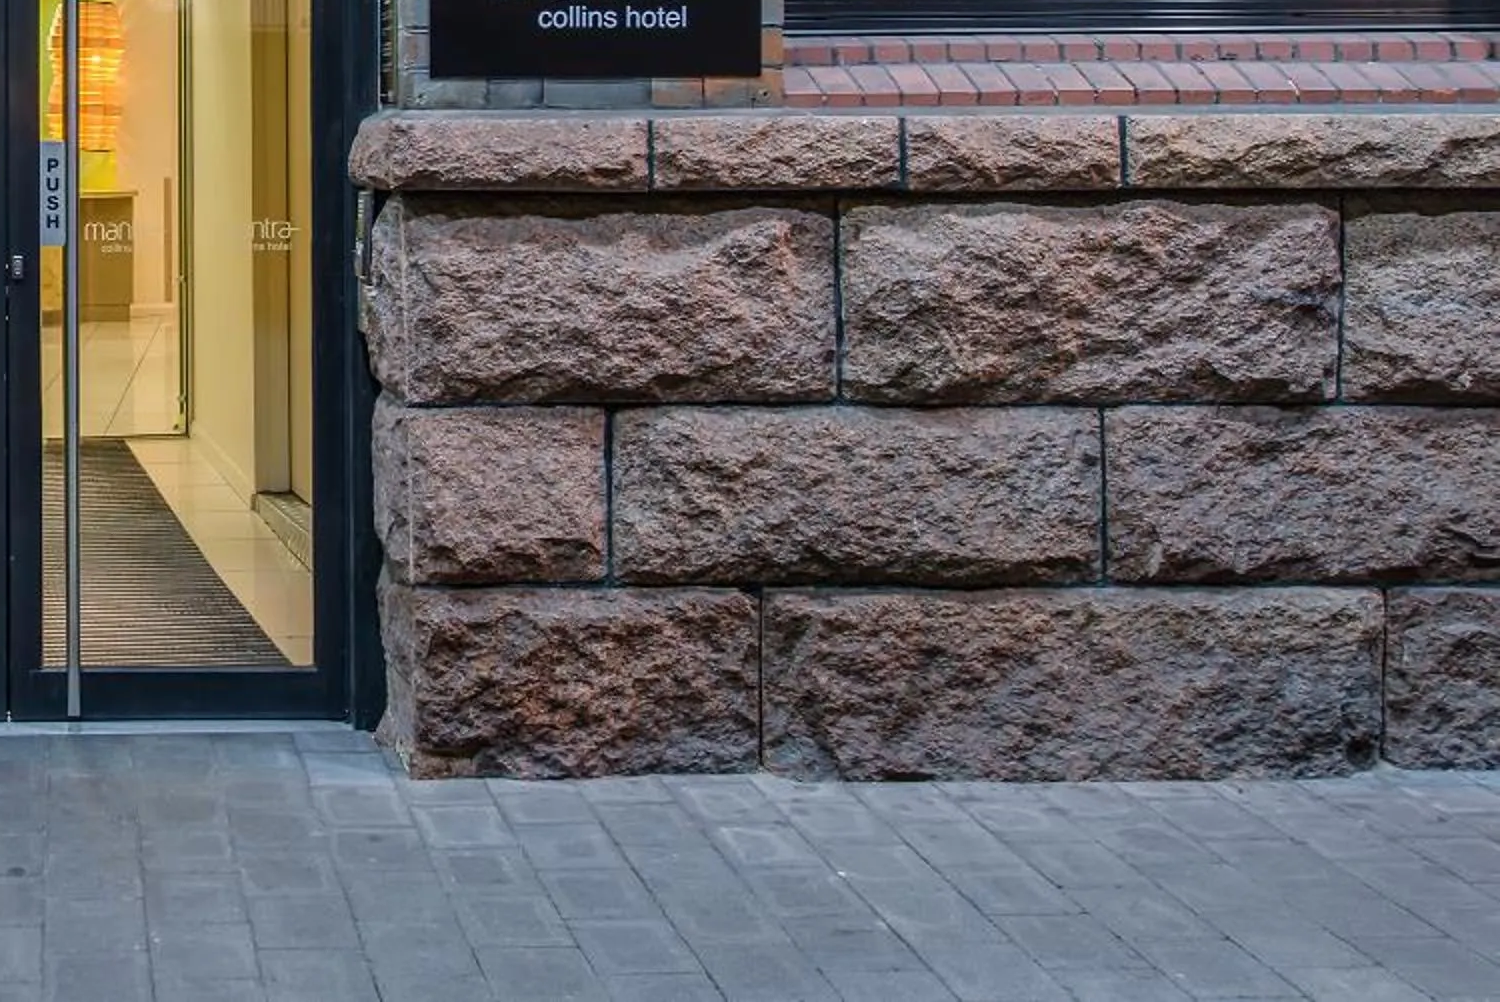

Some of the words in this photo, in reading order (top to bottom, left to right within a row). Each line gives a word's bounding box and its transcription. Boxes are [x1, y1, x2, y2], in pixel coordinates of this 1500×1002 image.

[538, 5, 618, 29] collins
[625, 5, 688, 29] hotel
[46, 158, 59, 229] PUSH
